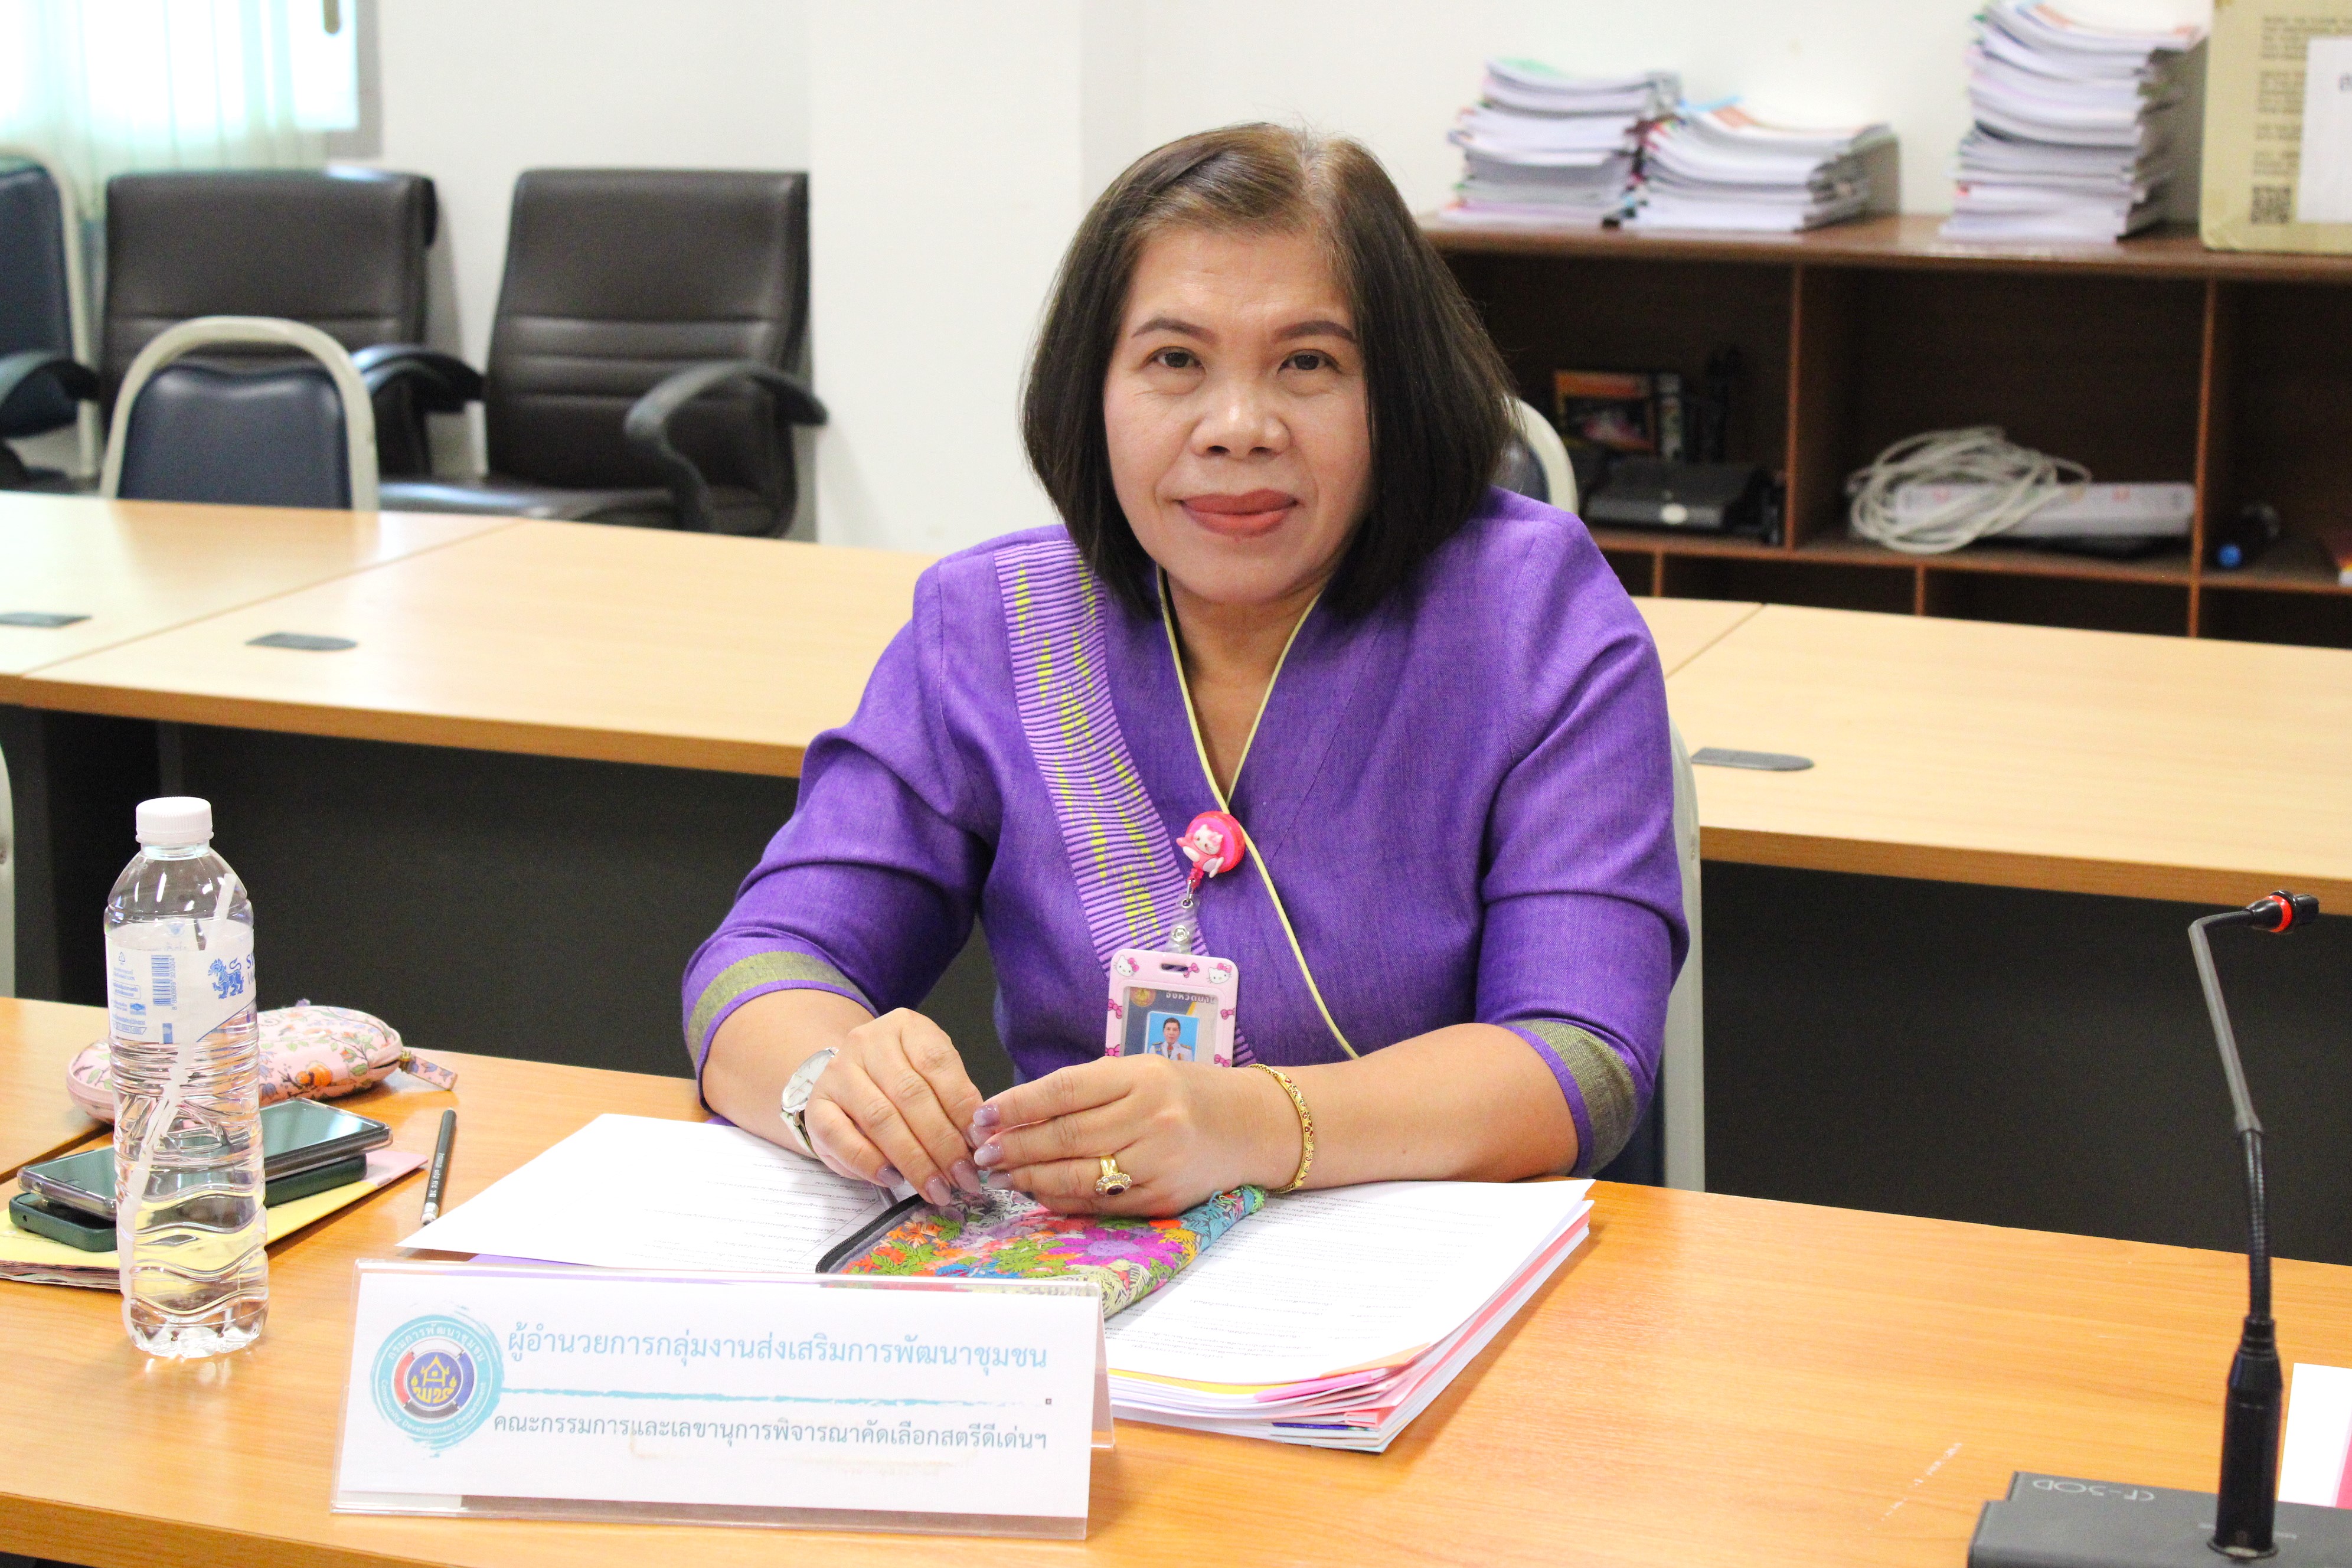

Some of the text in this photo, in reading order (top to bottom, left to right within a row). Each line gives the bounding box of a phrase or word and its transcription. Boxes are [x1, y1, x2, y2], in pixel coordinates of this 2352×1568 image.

[388, 1323, 485, 1362] กรมการพัฒนาชุมชน
[508, 1321, 1047, 1376] ผู้อำนวยการกลุ่มงานส่งเสริมการพัฒนาชุมชน
[381, 1379, 486, 1436] Community Development Department
[494, 1415, 1047, 1450] คณะกรรมการและเลขานุการพิจารณาคัดเลือกสตรีดีเด่นฯ
